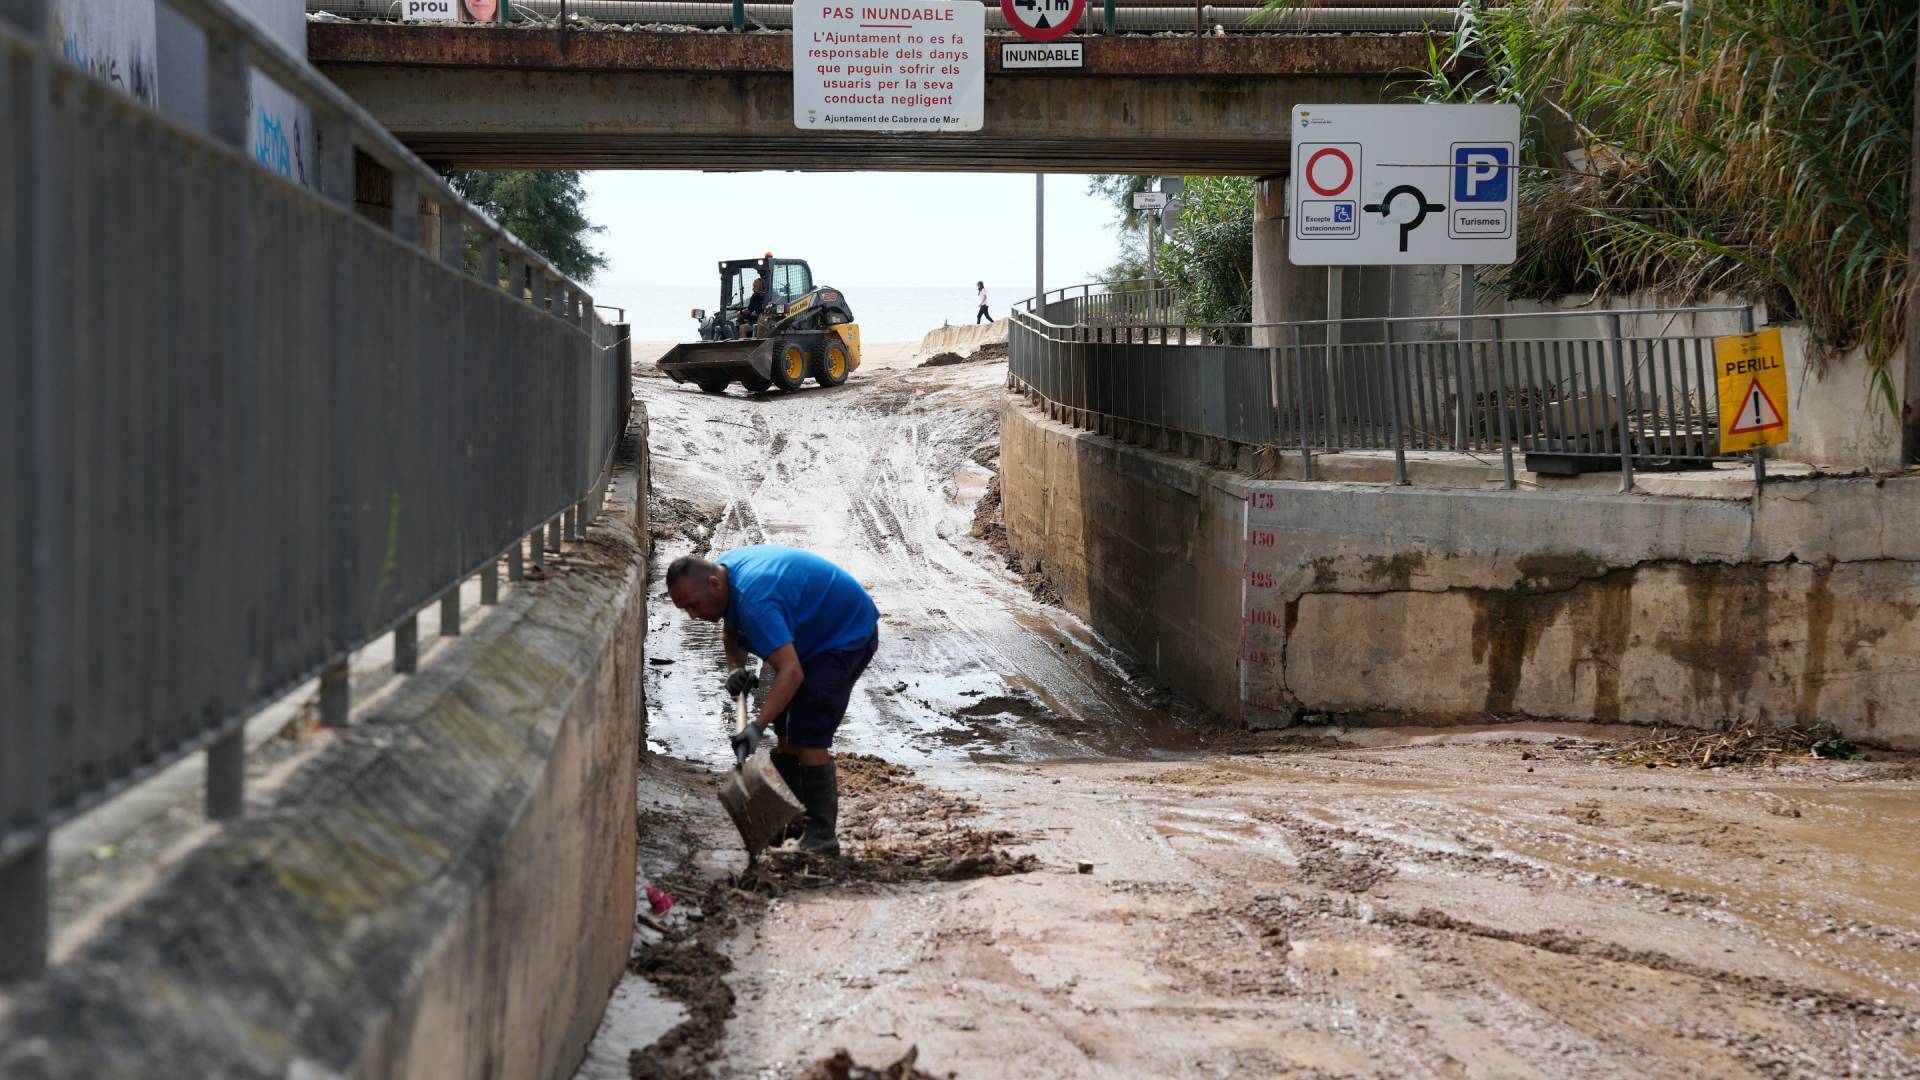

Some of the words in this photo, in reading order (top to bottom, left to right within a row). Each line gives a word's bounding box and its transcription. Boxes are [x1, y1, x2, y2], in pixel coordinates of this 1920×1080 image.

[410, 1, 448, 15] prou
[822, 7, 855, 19] PAS
[862, 7, 955, 21] INUNDABLE
[813, 31, 901, 45] L'Ajuntament
[907, 35, 924, 44] no
[929, 35, 945, 44] es
[951, 33, 964, 45] fa
[808, 48, 889, 60] responsable
[895, 48, 923, 59] dels
[929, 48, 969, 62] danys
[1005, 49, 1079, 62] INUNDABLE
[817, 64, 841, 76] que
[847, 64, 893, 76] puguin
[899, 64, 936, 75] sofrir
[941, 64, 960, 75] els
[823, 79, 872, 89] usuaris
[878, 81, 900, 92] per
[905, 79, 917, 90] la
[923, 81, 954, 90] seva
[824, 93, 885, 105] conducta
[891, 94, 953, 107] negligent
[824, 114, 877, 123] Ajuntament
[878, 115, 890, 123] de
[891, 115, 928, 124] Cabrera
[929, 115, 941, 124] de
[942, 115, 960, 124] Mar
[1466, 153, 1499, 196] P
[1460, 217, 1501, 226] Turismes
[1726, 355, 1780, 377] PERILL
[1252, 492, 1274, 509] 175
[1251, 529, 1274, 547] 150
[1251, 571, 1273, 588] 125
